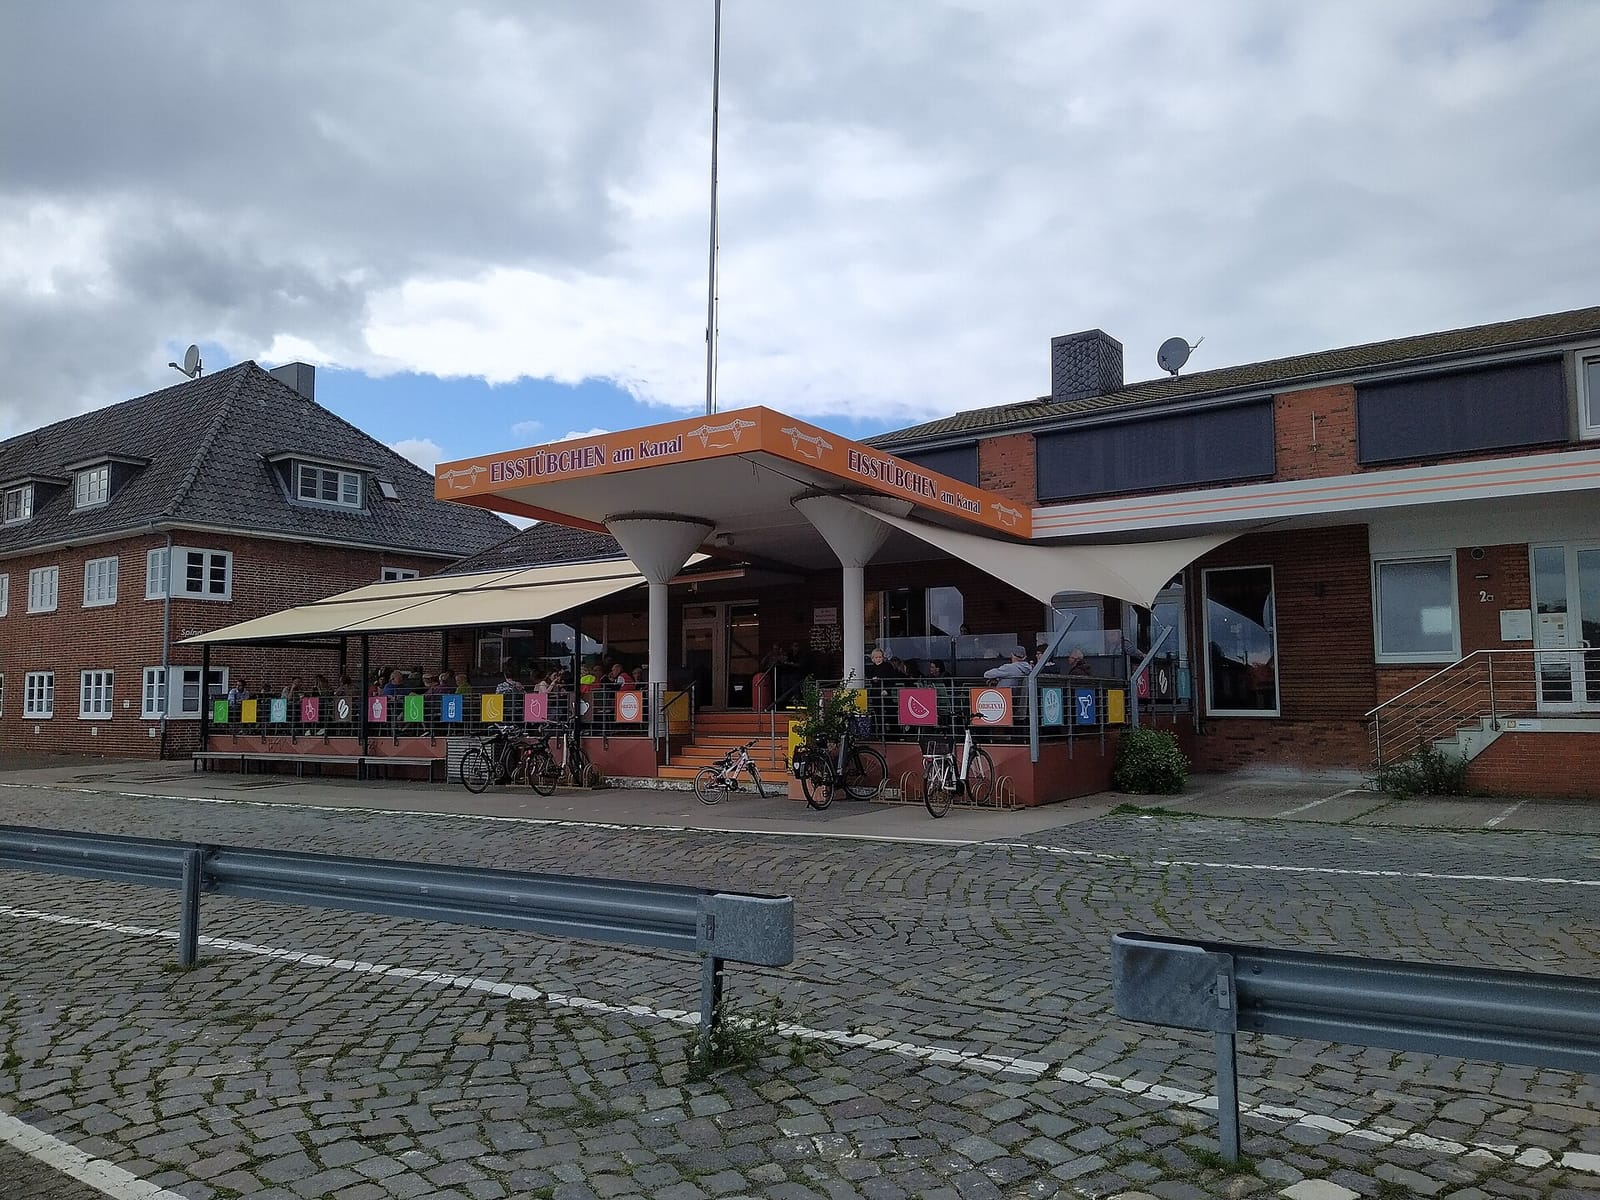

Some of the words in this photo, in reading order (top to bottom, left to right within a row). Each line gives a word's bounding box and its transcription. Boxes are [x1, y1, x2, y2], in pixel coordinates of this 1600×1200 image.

[490, 444, 607, 483] EISSTÜBCHEN
[612, 447, 635, 464] am
[639, 434, 682, 459] Kanal
[848, 448, 937, 499] EISSTÜBCHEN
[941, 490, 954, 506] am
[957, 492, 981, 515] Kanal
